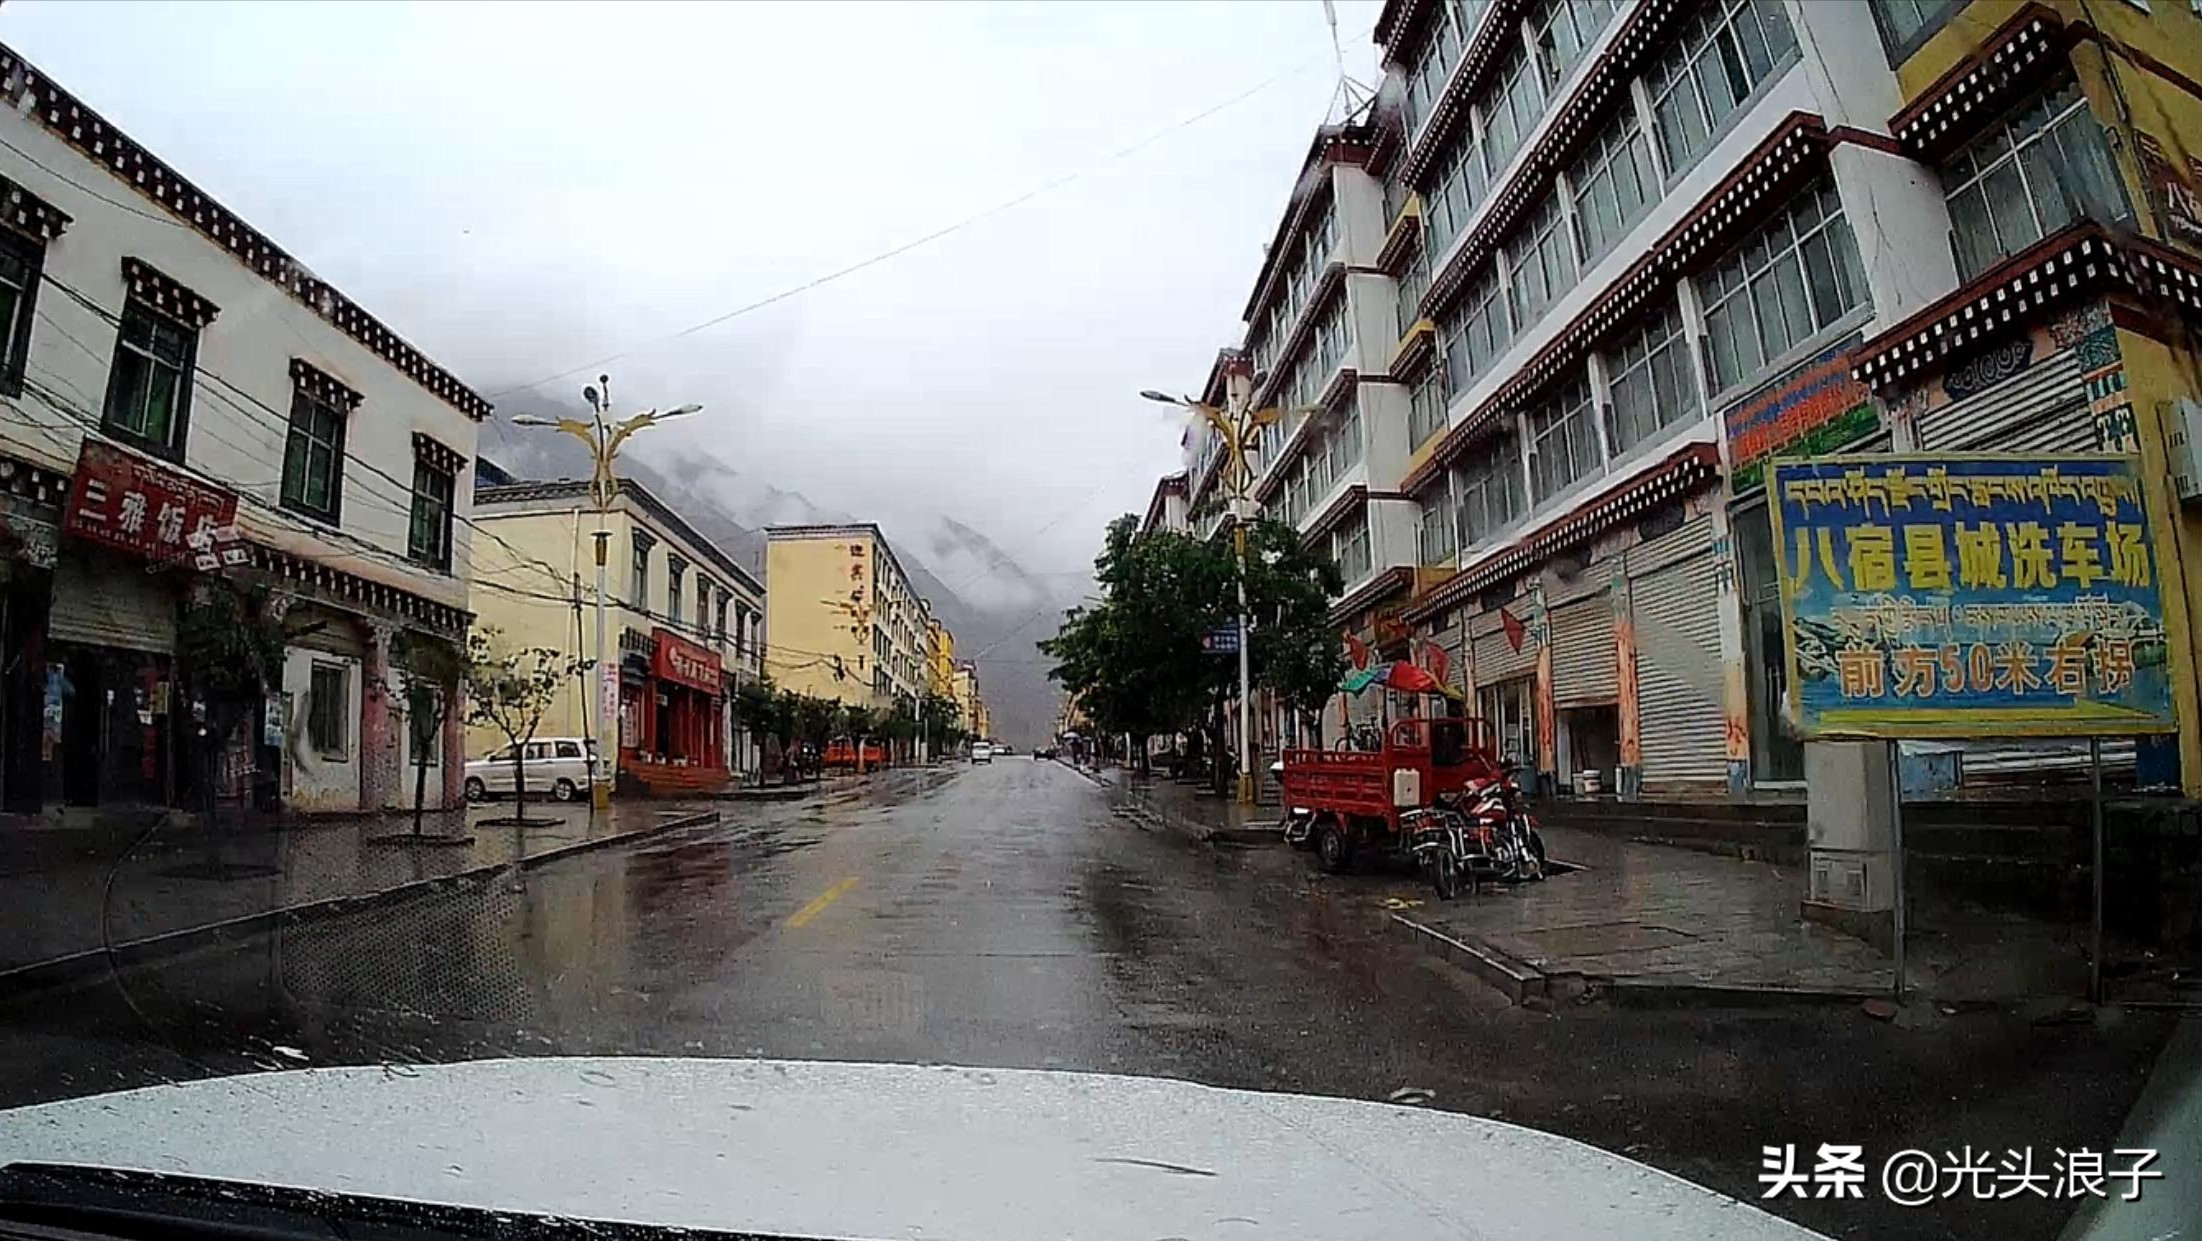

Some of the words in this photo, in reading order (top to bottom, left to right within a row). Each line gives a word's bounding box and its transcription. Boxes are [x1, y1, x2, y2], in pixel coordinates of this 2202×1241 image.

[1795, 521, 2151, 591] 八宿县城洗车场
[1835, 633, 2136, 698] 前方50米右拐
